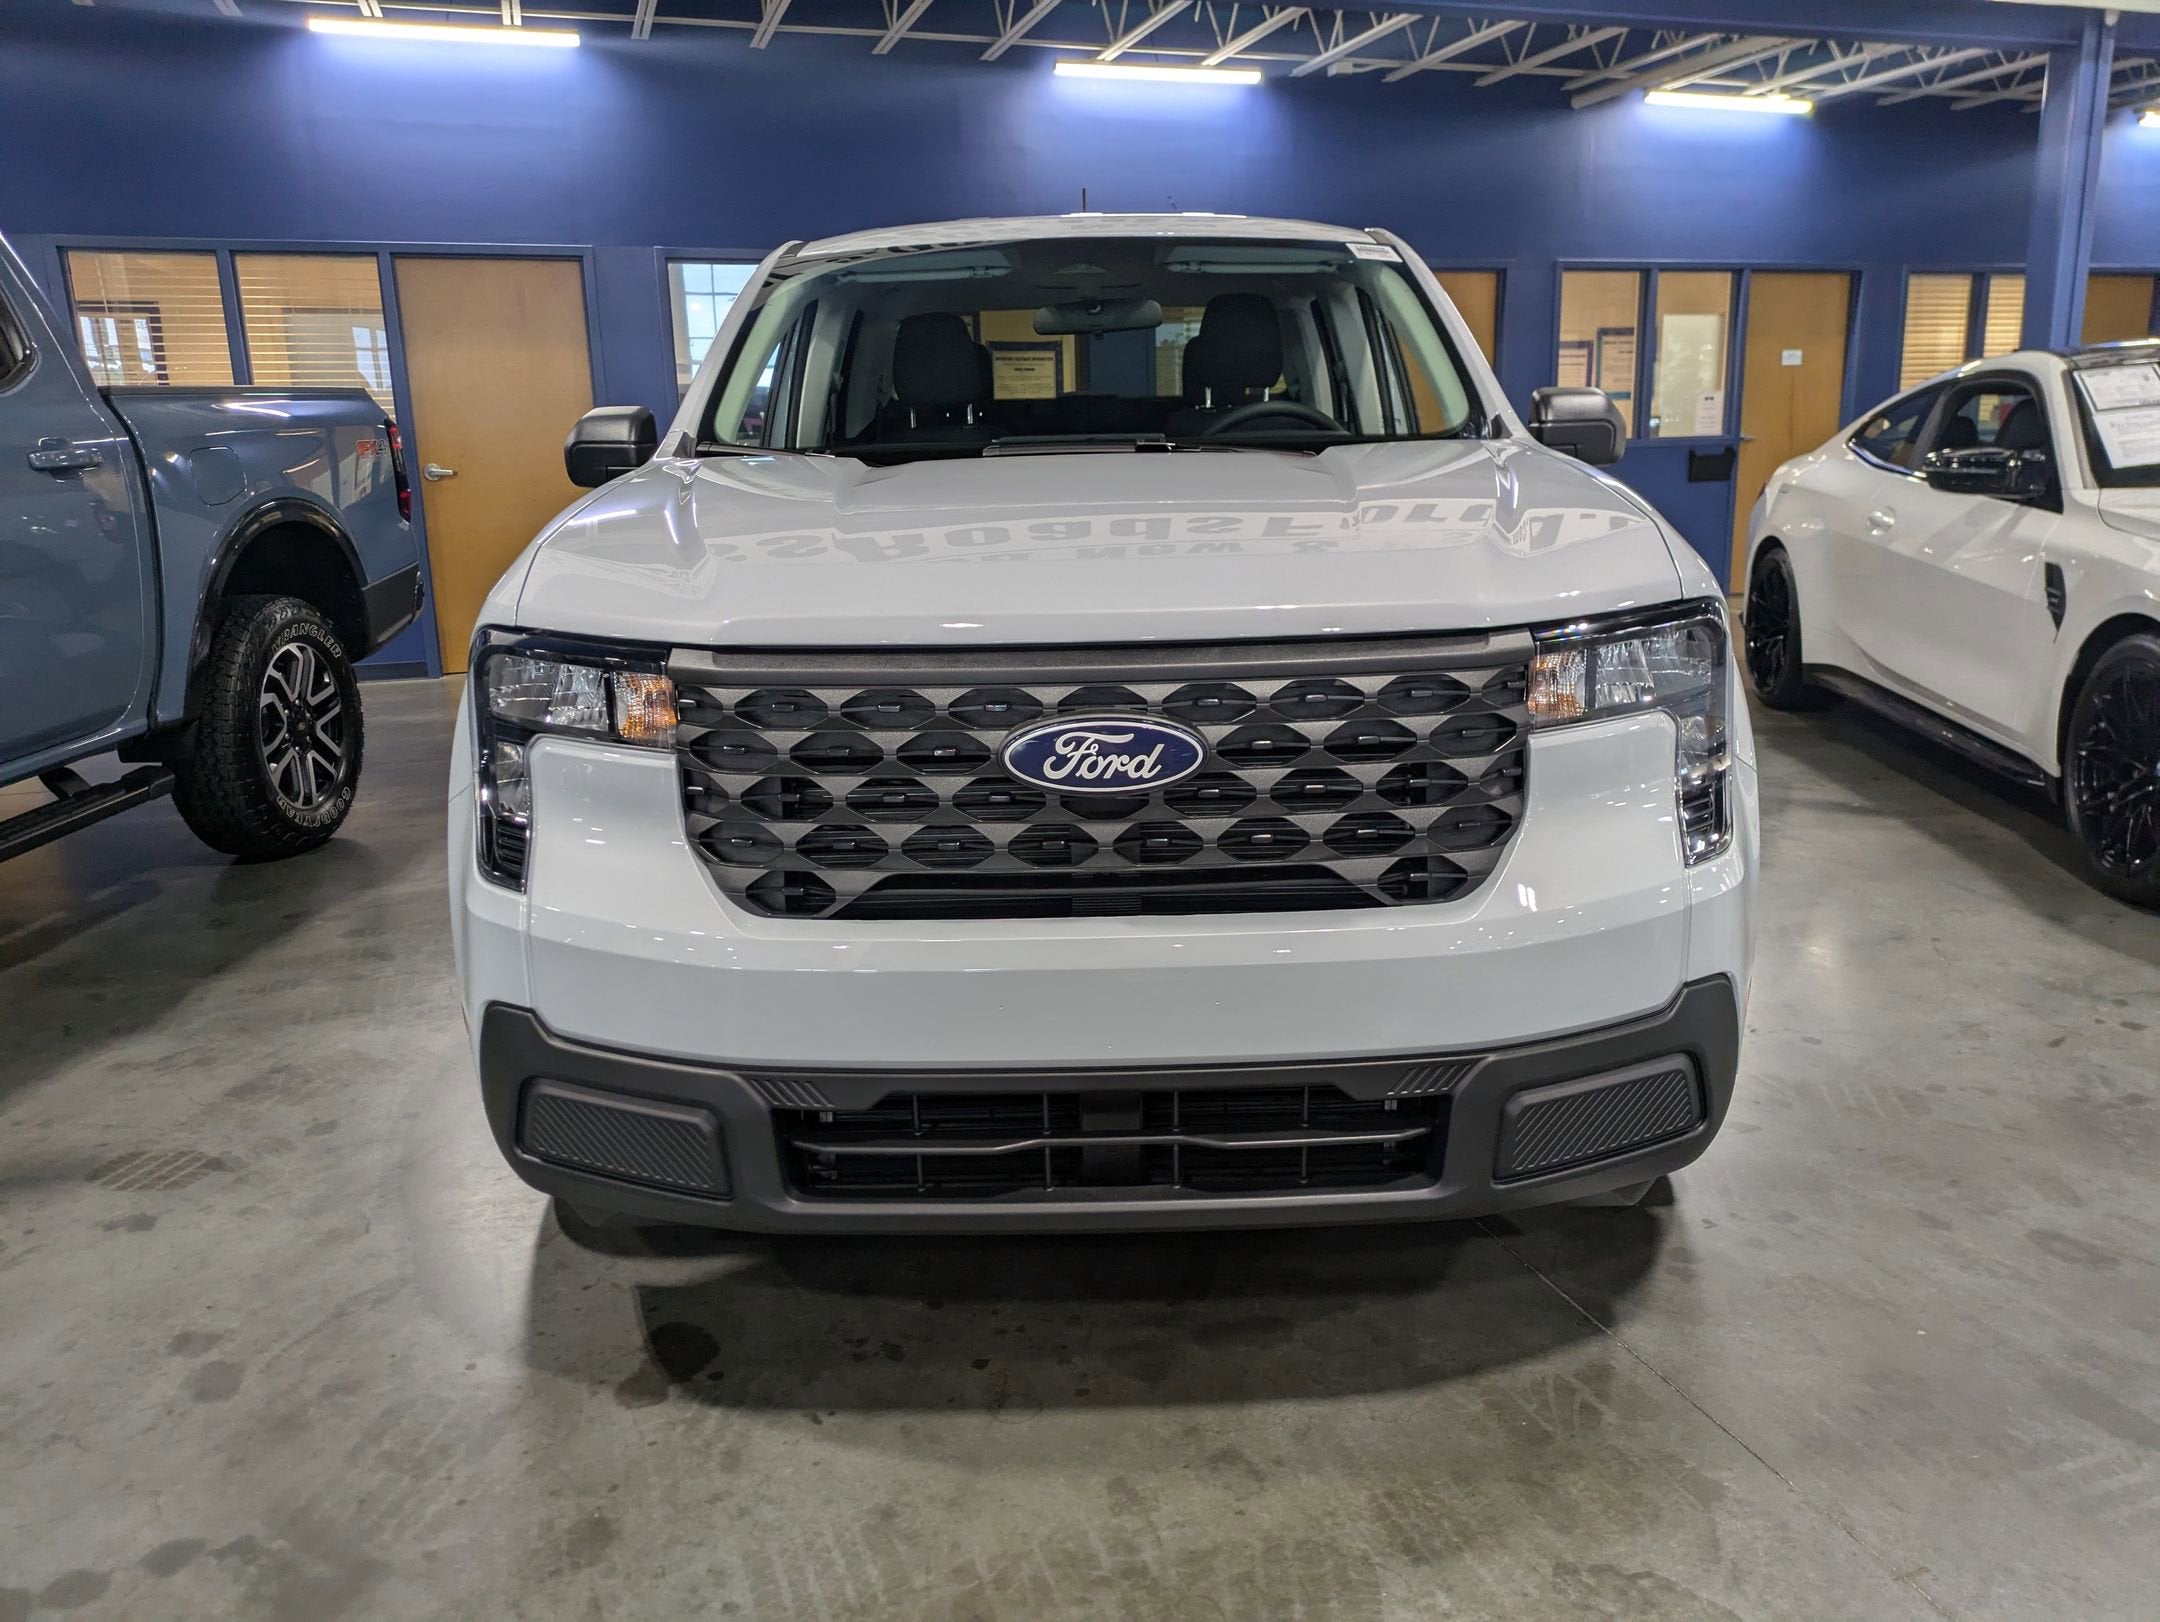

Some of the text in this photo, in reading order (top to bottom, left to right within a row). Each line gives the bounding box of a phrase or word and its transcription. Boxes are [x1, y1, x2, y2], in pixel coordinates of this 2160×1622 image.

[356, 439, 387, 460] FX4
[271, 622, 342, 659] WRANGLER
[1043, 731, 1165, 780] Ford
[276, 786, 351, 828] GOODYEAR
